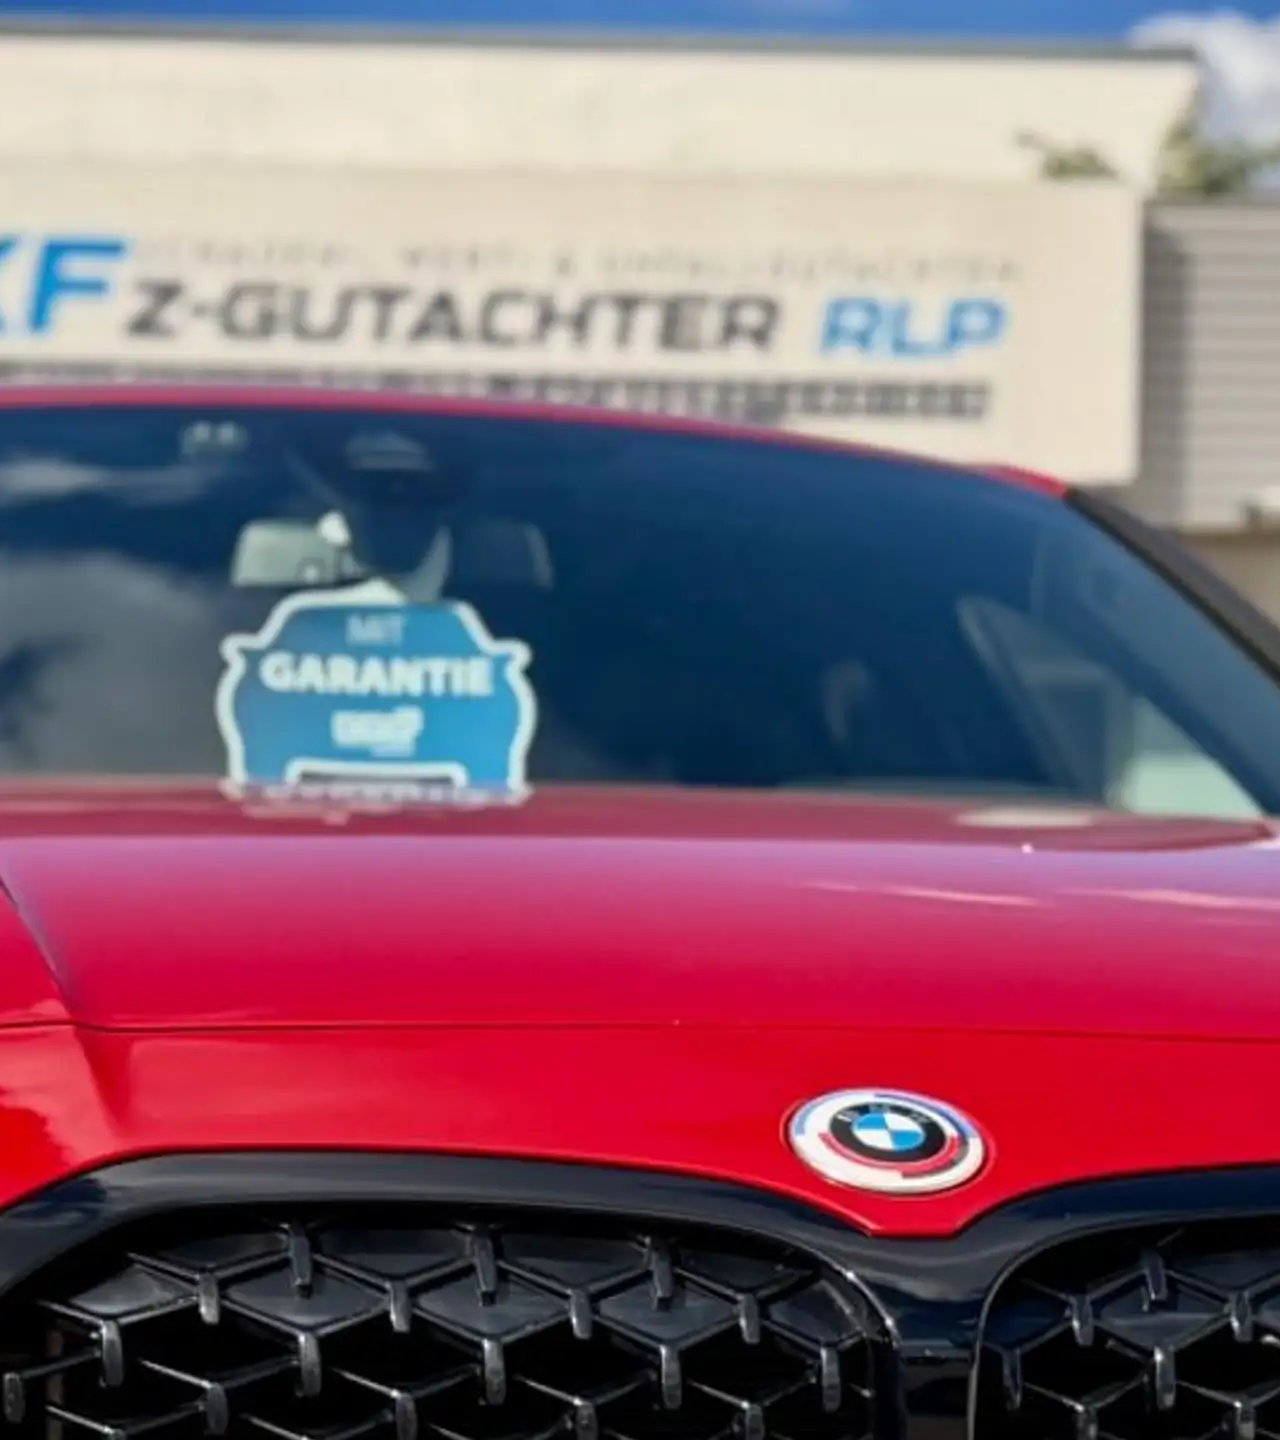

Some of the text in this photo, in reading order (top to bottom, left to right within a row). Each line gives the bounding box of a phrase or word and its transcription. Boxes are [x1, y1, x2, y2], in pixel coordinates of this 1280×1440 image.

[818, 293, 1006, 357] RLP
[345, 614, 407, 646] MIT
[258, 651, 494, 697] GARANTIE
